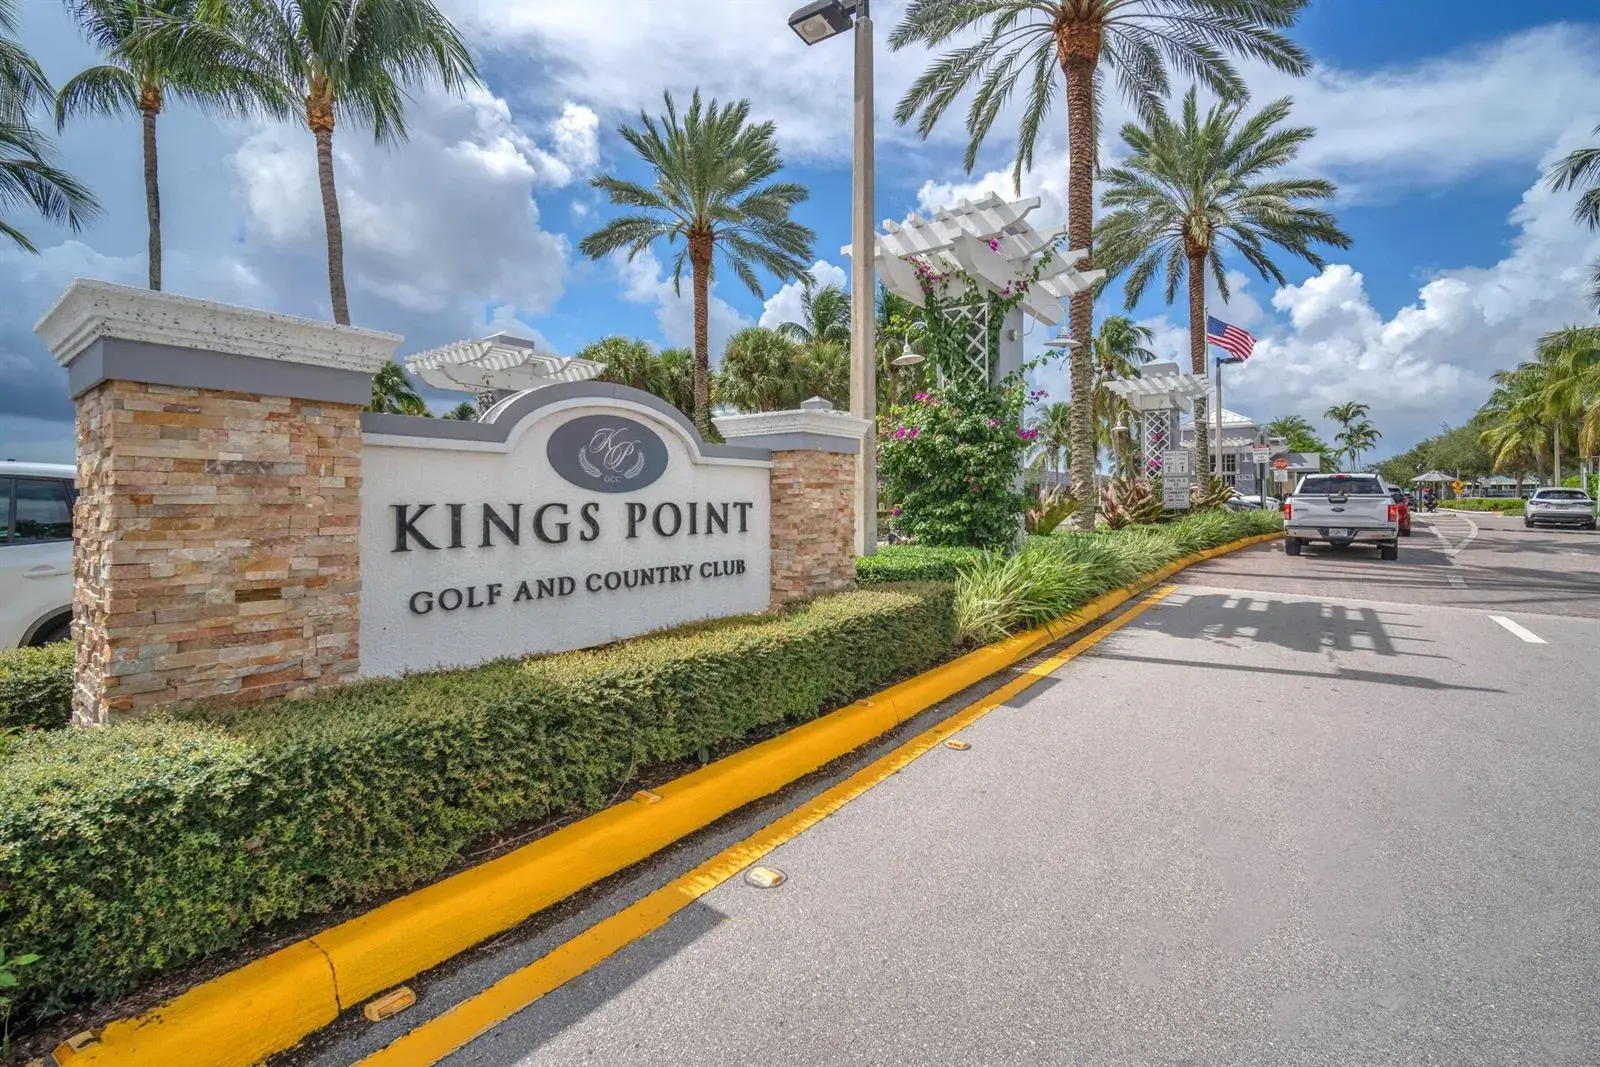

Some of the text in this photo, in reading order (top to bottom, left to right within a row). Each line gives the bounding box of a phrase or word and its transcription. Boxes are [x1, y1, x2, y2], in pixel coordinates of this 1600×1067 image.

[389, 502, 753, 554] KINGS POINT
[409, 559, 746, 616] GOLF AND COUNTRY CLUB
